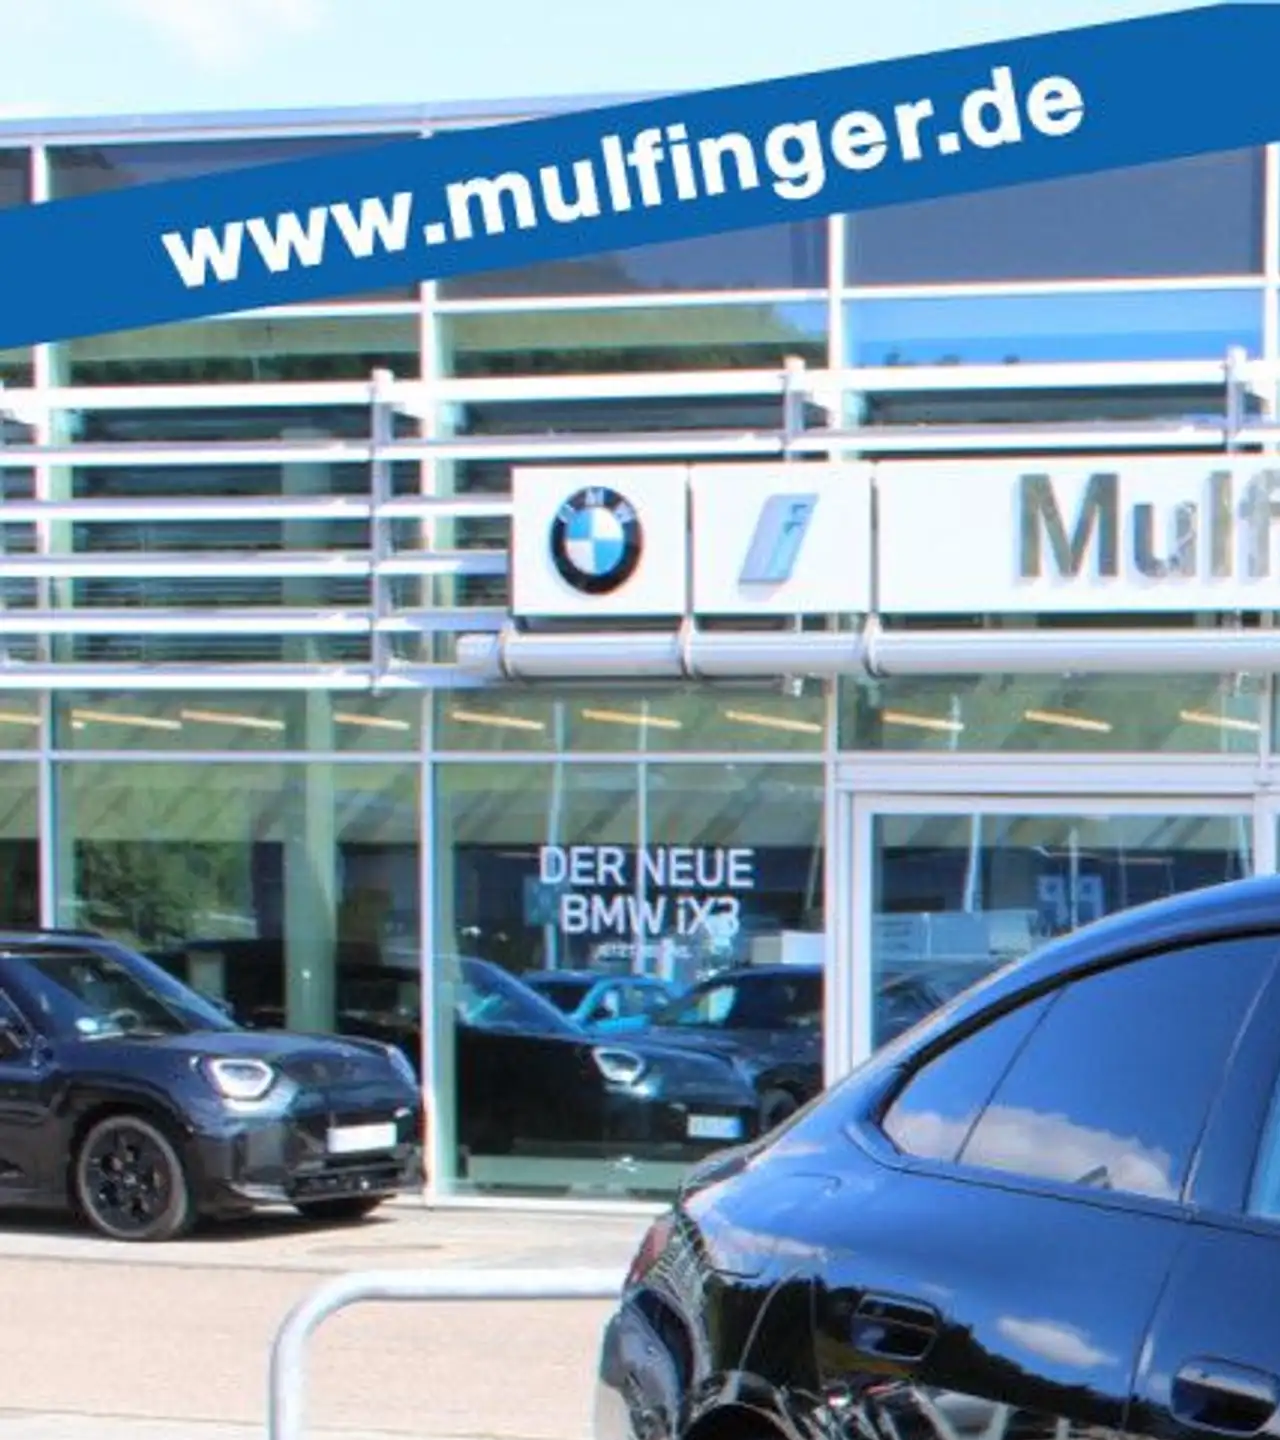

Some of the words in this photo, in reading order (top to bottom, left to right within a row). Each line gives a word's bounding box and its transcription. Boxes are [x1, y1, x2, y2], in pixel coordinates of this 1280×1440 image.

[539, 846, 626, 886] DER
[636, 849, 755, 889] NEUE
[559, 893, 668, 935] BMW
